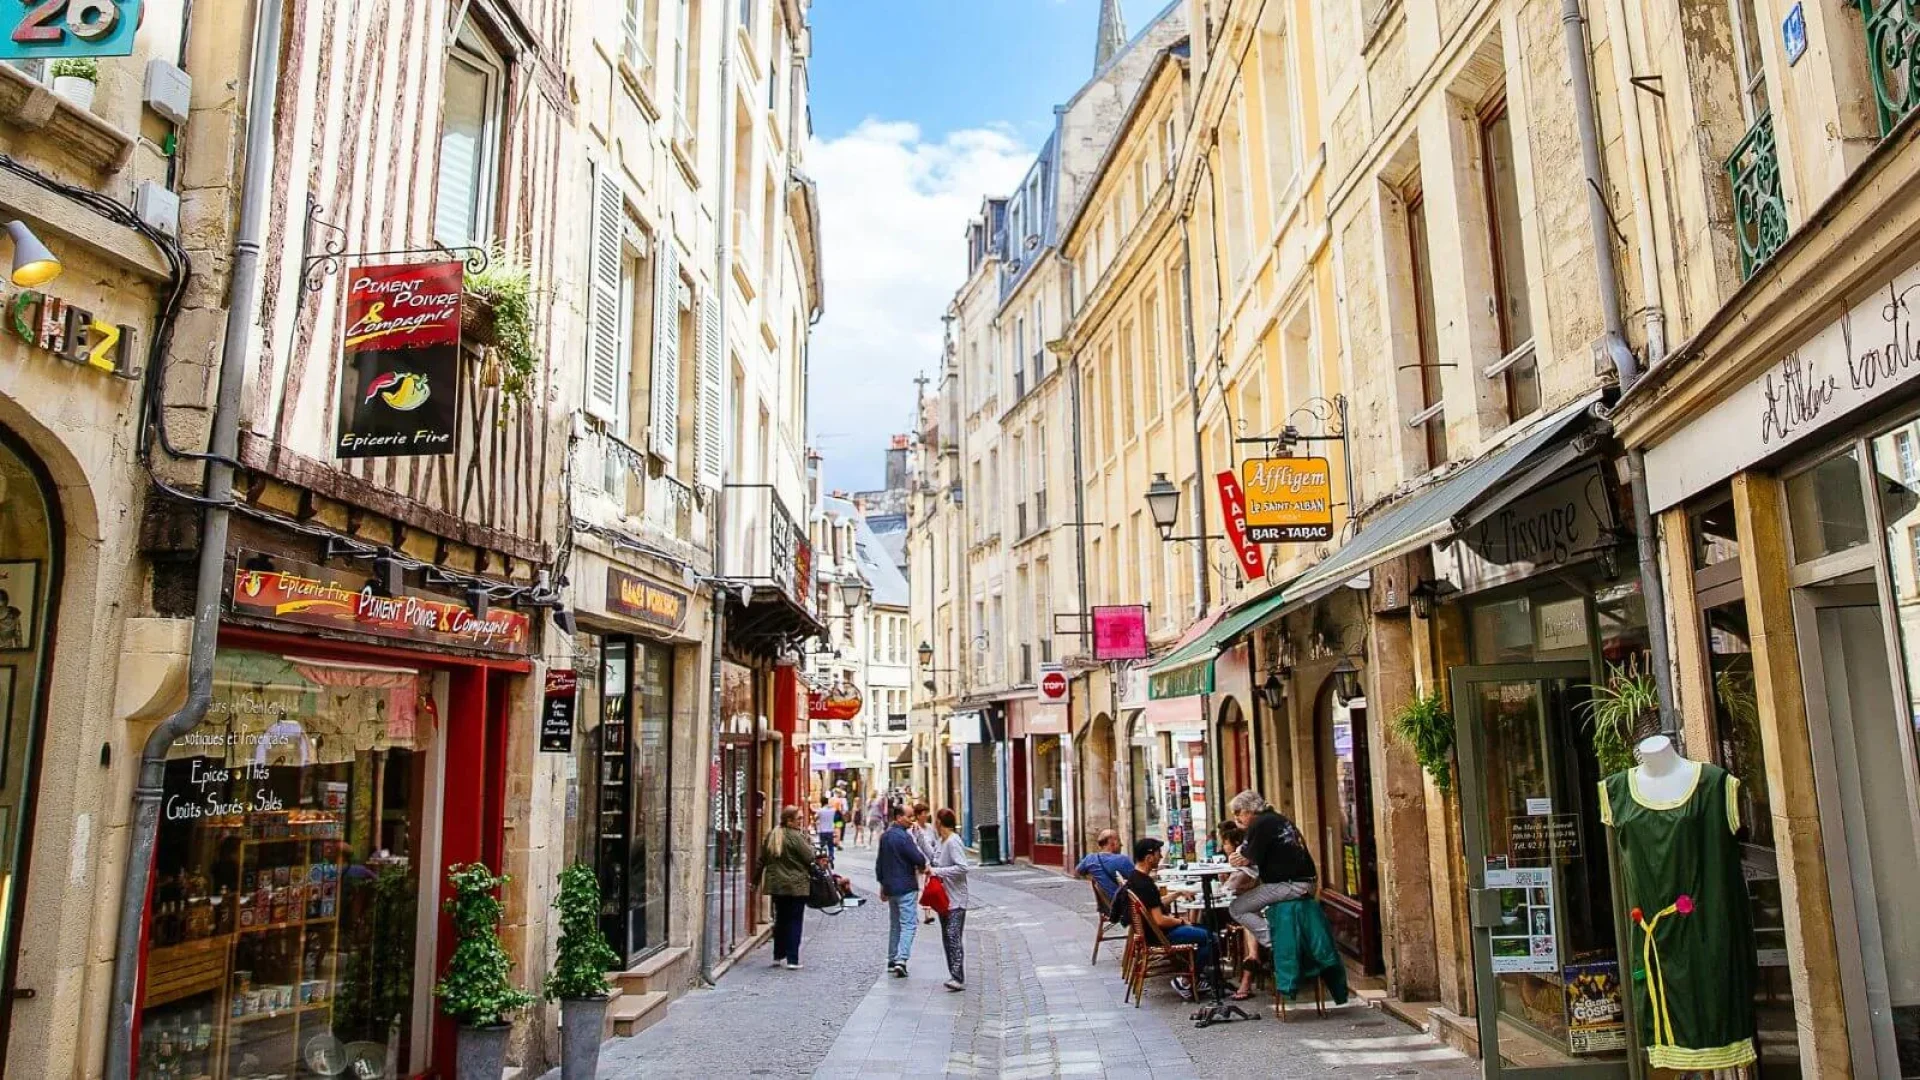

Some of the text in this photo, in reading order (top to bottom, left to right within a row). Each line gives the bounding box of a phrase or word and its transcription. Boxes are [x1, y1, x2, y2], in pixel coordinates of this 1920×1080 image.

[346, 304, 455, 336] Compagnie
[362, 302, 385, 324] &
[341, 430, 450, 451] Epicerie Fine
[1248, 462, 1326, 493] Affligem
[1500, 502, 1580, 565] Tissage
[278, 570, 325, 599] Epicerie
[326, 581, 349, 602] Fine
[438, 604, 452, 632] &
[452, 609, 510, 646] Compagnie
[245, 758, 270, 780] Thés
[166, 794, 201, 820] Goûts
[1573, 1003, 1621, 1019] GOSPEL
